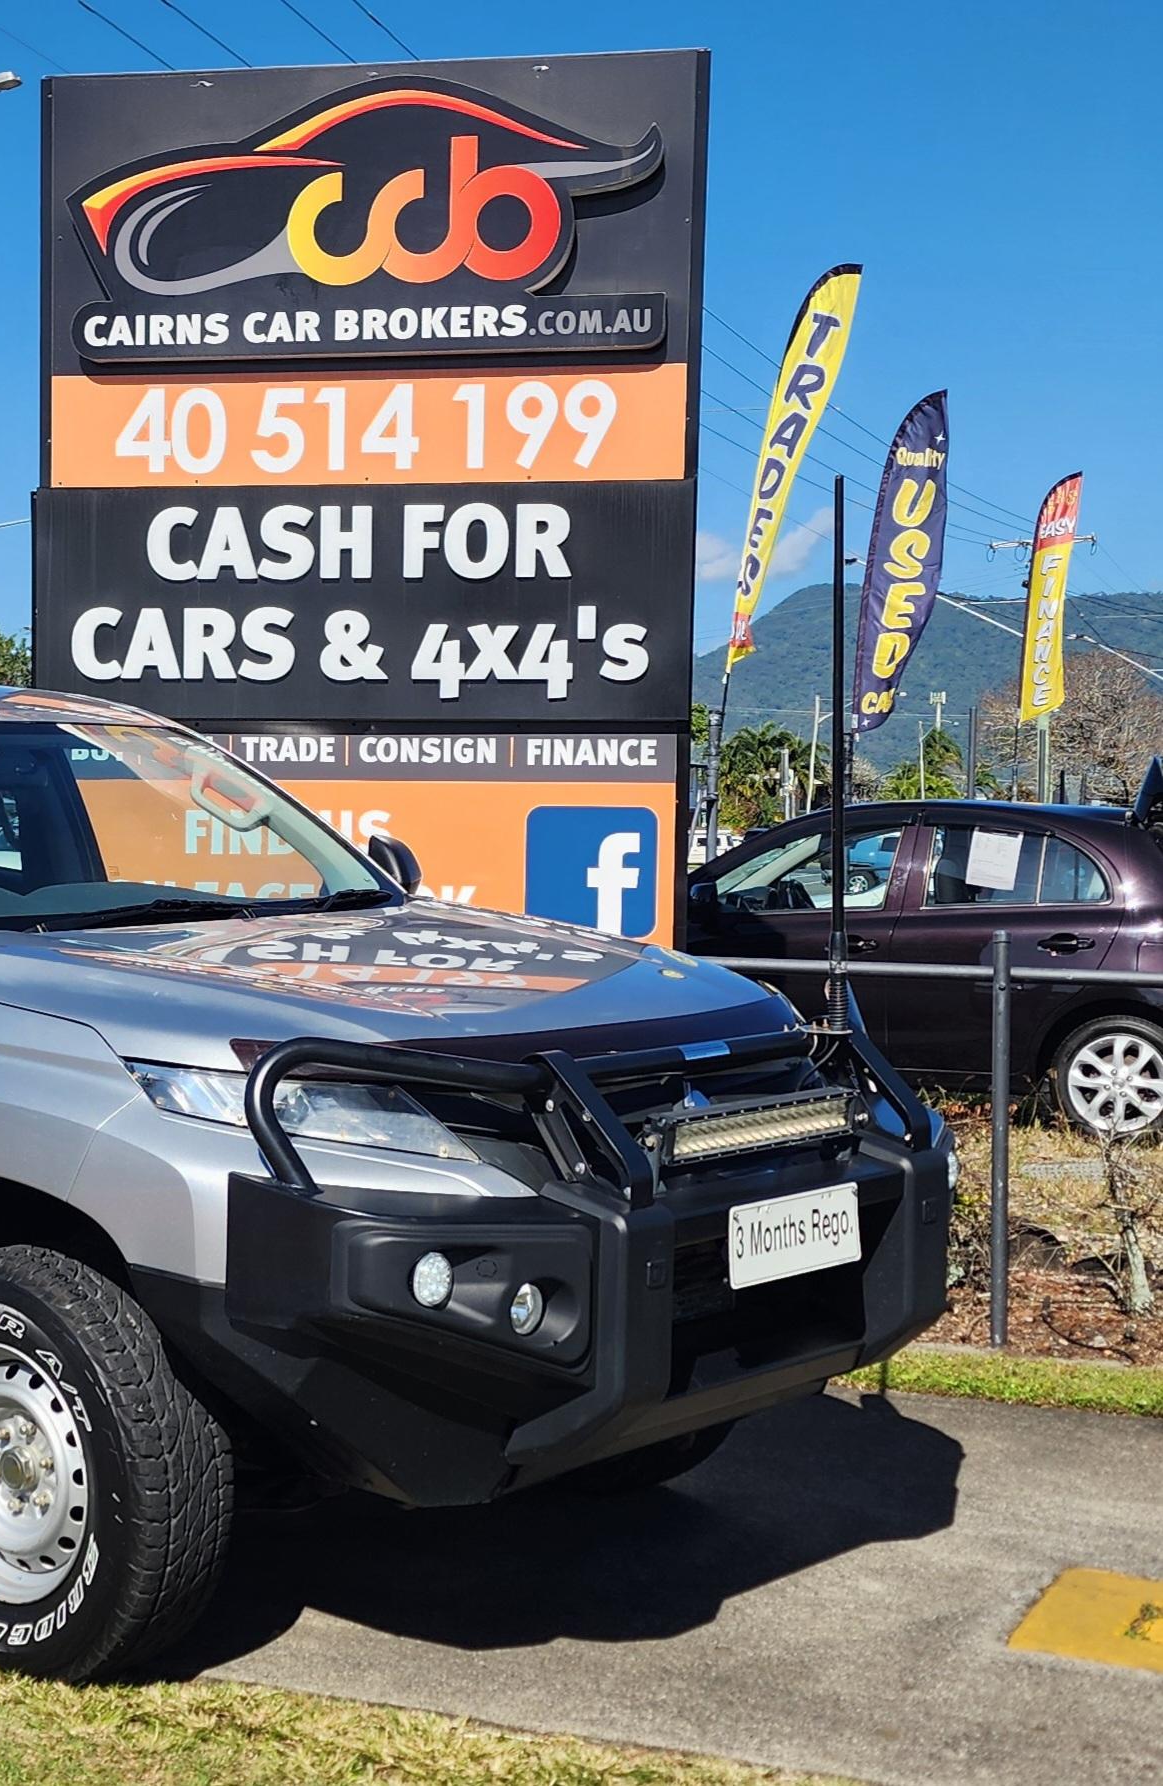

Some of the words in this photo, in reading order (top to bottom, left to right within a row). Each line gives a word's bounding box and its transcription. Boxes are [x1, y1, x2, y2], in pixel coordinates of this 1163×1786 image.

[84, 312, 230, 347] CAIRNS
[243, 311, 321, 344] CAR
[115, 387, 228, 475] 40
[250, 385, 421, 475] 514
[453, 379, 618, 470] 199
[736, 312, 841, 597] TRADES
[896, 446, 946, 470] Quality
[146, 505, 373, 581] CASH
[403, 503, 573, 580] FOR
[1039, 517, 1077, 539] EASY
[871, 478, 937, 679] USED
[71, 606, 296, 682] CARS
[319, 609, 390, 682] &
[1032, 554, 1063, 707] FINANCE
[241, 736, 336, 764] TRADE
[358, 736, 498, 765] CONSIGN
[527, 738, 659, 767] FINANCE
[736, 1225, 745, 1260] 3
[750, 1214, 807, 1256] Months
[811, 1207, 854, 1246] Rego.
[35, 1349, 93, 1432] A/T
